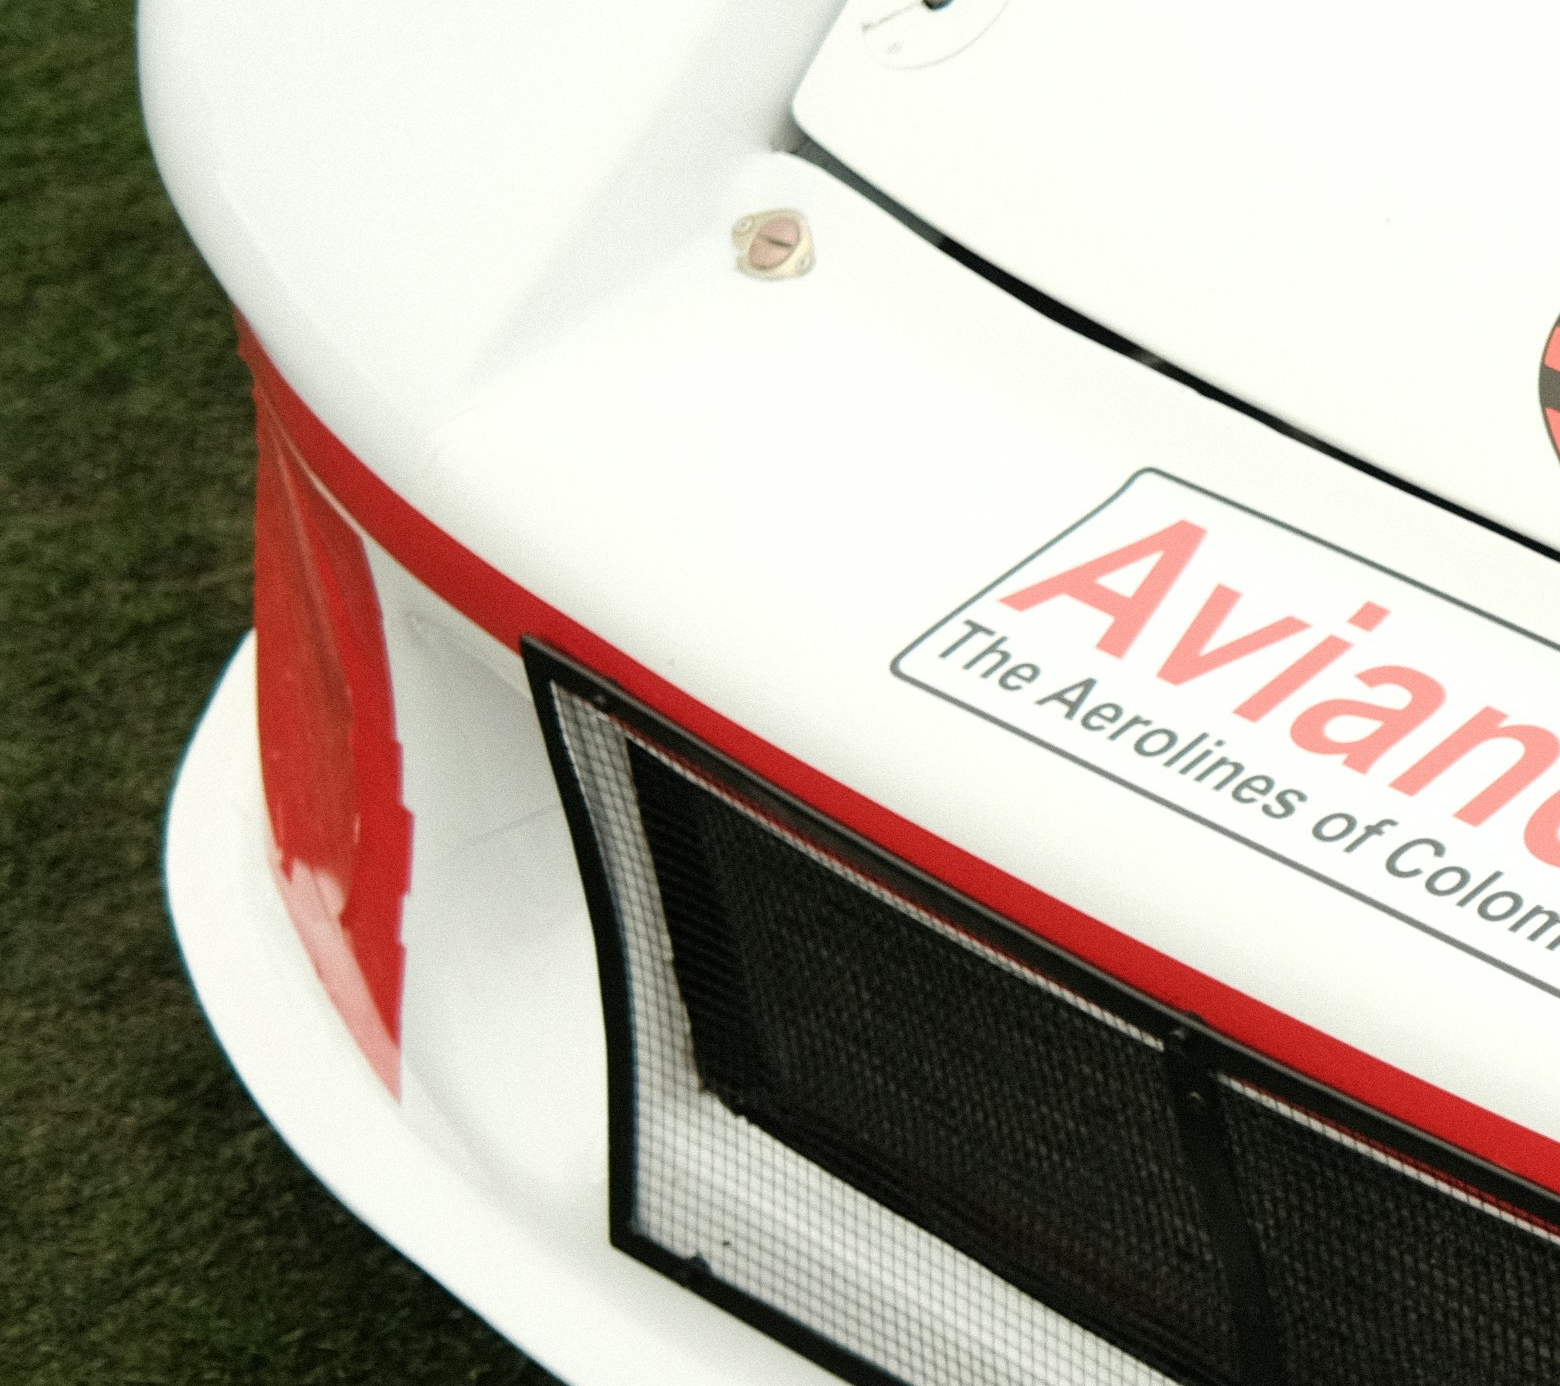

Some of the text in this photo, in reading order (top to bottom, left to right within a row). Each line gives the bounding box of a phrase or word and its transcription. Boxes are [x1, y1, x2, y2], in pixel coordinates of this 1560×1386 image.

[936, 618, 1042, 693] The
[1036, 675, 1310, 823] Aerolines
[1311, 811, 1396, 855] of
